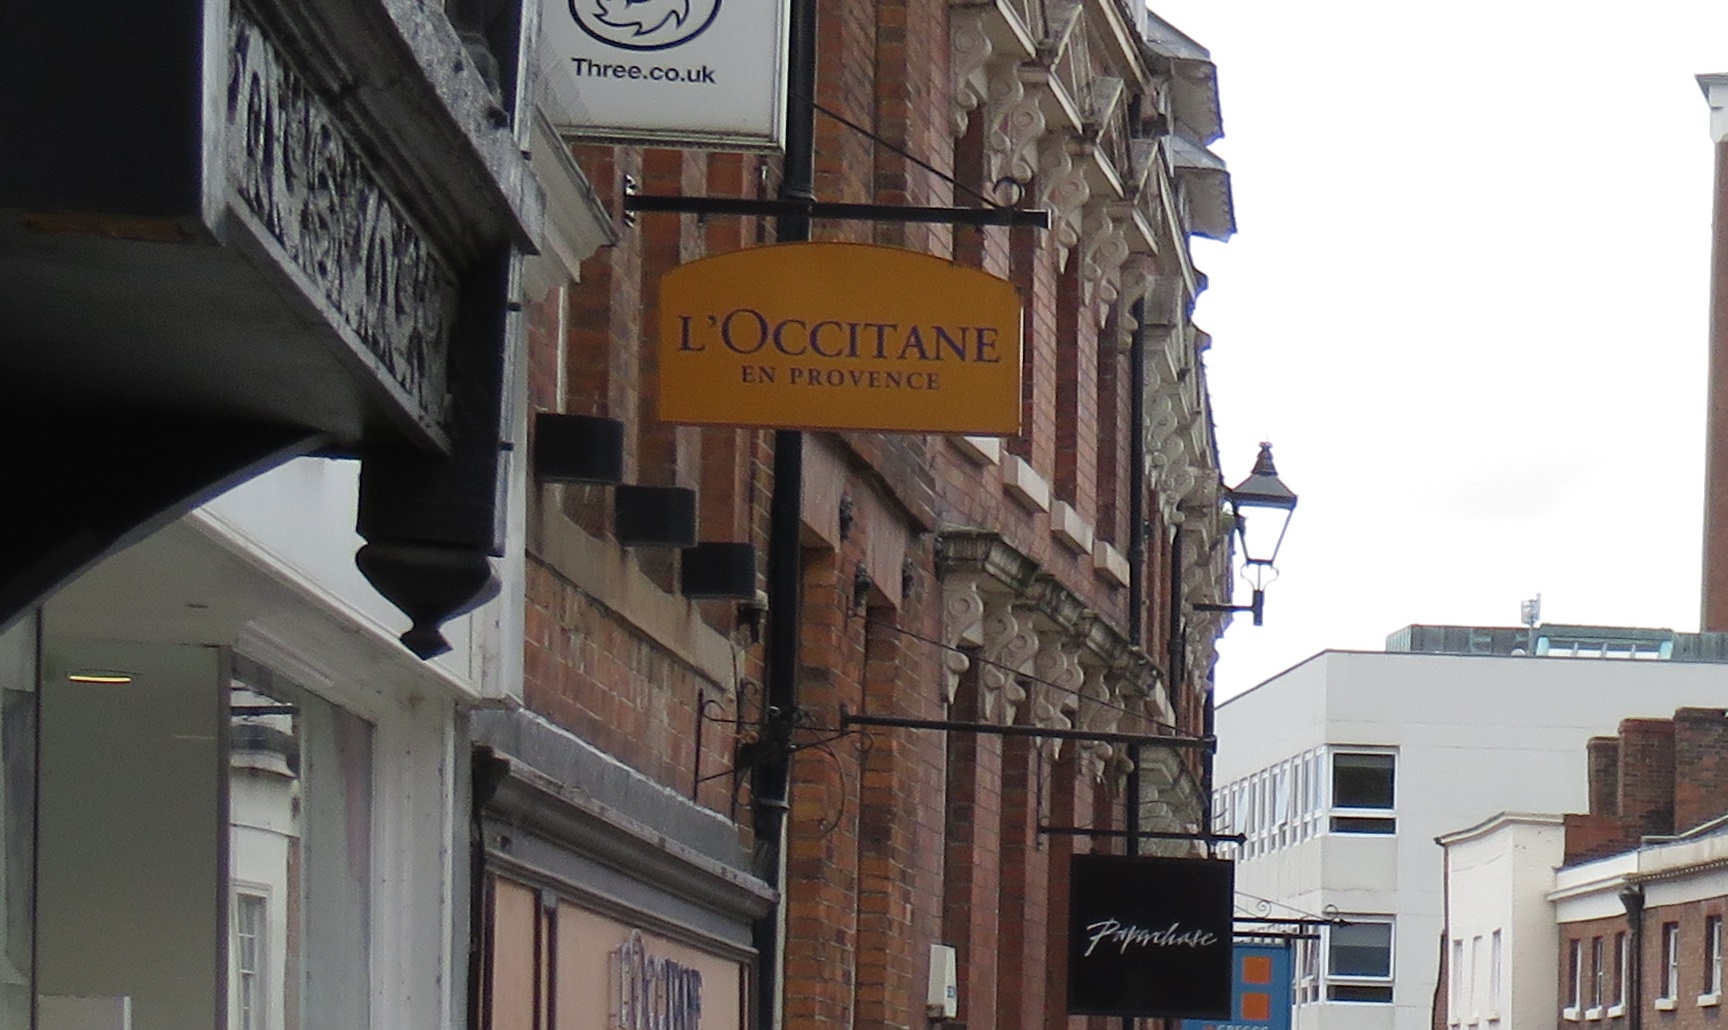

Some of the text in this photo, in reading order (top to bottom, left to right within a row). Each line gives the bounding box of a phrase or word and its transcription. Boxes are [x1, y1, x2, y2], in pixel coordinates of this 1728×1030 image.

[571, 57, 717, 84] Three.co.uk
[741, 365, 941, 391] EN PROVENCE
[1083, 917, 1218, 957] Paperchase
